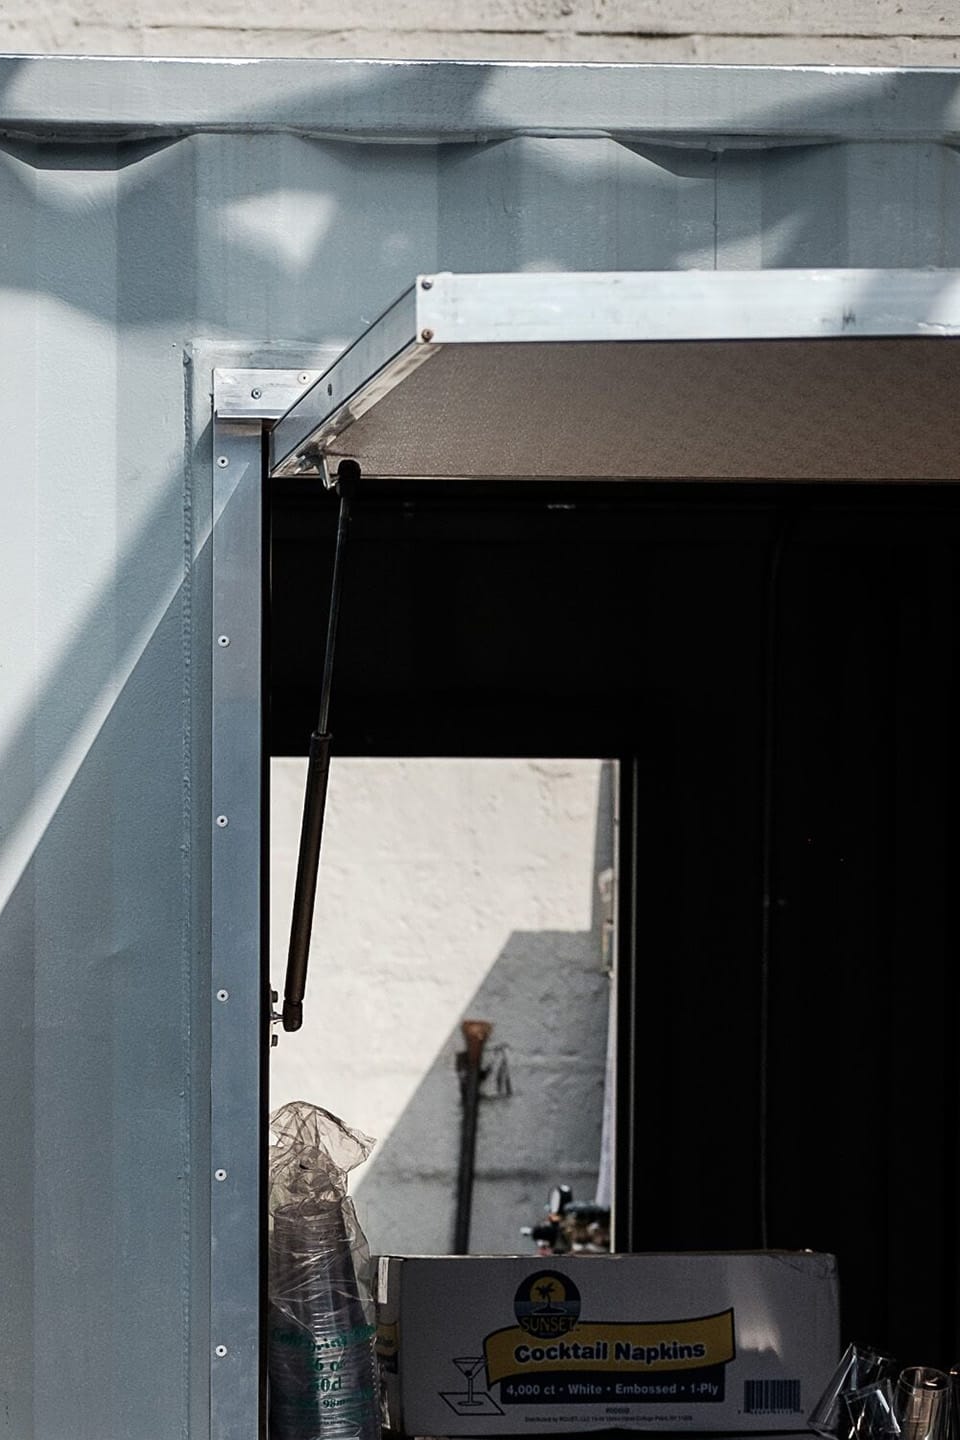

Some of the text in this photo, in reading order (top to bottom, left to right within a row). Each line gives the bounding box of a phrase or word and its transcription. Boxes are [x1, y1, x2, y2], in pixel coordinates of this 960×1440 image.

[520, 1316, 576, 1332] SUNSET
[514, 1341, 705, 1365] Cocktail Napkins
[506, 1382, 719, 1398] 4,000 ct White Embossed 1-Ply
